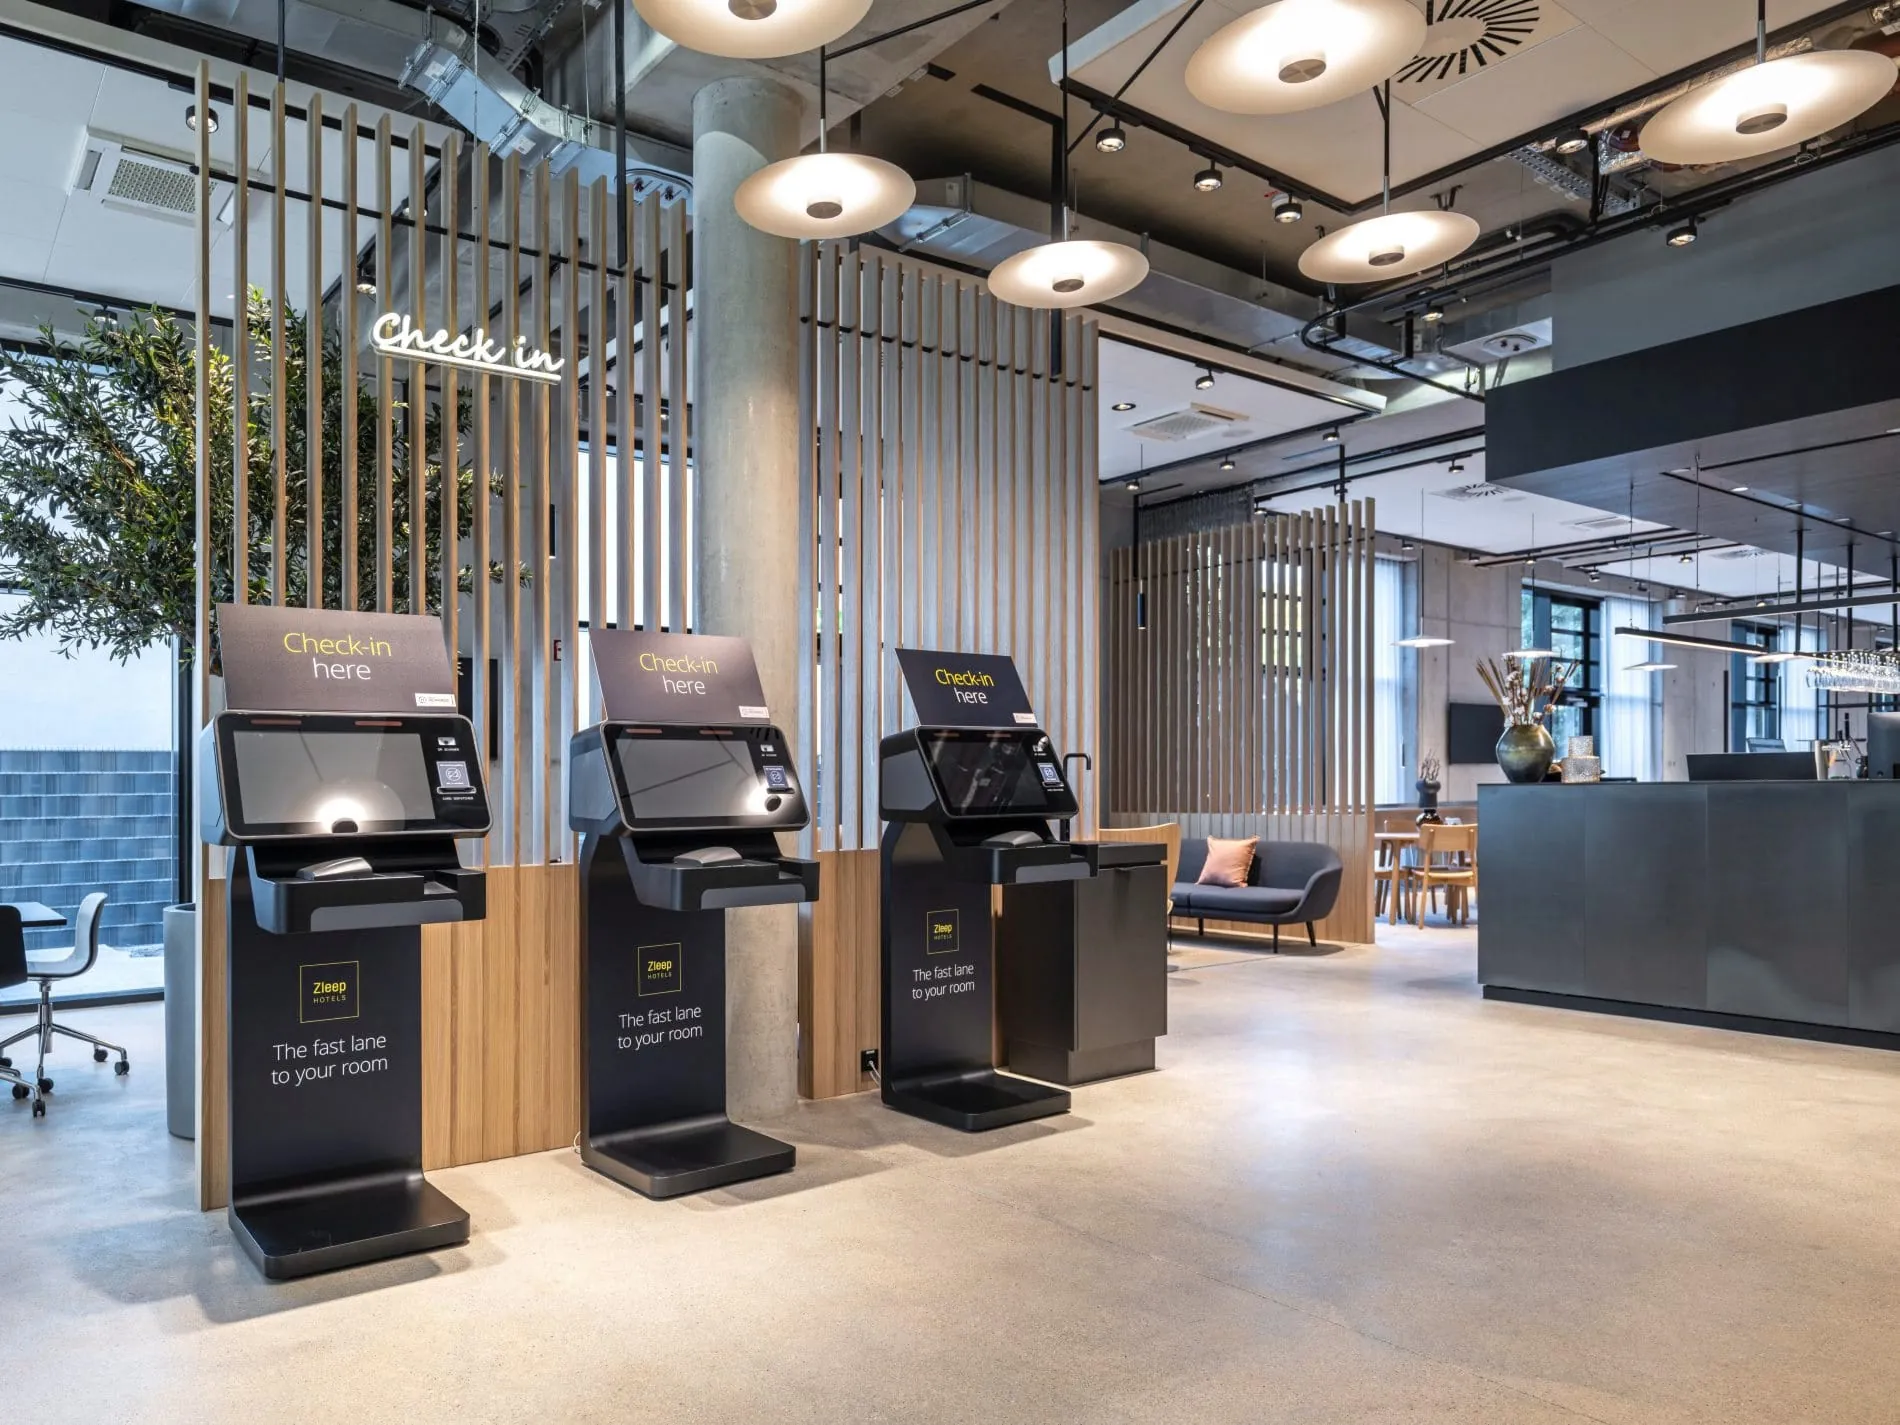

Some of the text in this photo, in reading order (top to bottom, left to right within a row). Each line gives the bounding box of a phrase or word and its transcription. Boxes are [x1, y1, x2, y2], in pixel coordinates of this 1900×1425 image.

[372, 312, 565, 372] Check in
[283, 632, 392, 657] Check-in
[312, 657, 372, 680] here
[639, 652, 719, 674] Check-in
[662, 675, 706, 695] here
[935, 668, 995, 687] Check-in
[953, 687, 989, 704] here
[933, 924, 953, 934] Zleep
[647, 960, 672, 972] Zleep
[647, 971, 673, 980] HOTELS
[912, 963, 974, 982] The fast lane
[313, 981, 347, 995] Zleep
[912, 981, 975, 1001] to your room
[313, 994, 347, 1004] HOTELS
[618, 1006, 702, 1029] The fast lane
[272, 1035, 387, 1061] The fast lane
[617, 1025, 703, 1051] to your room
[271, 1057, 388, 1087] to your room
